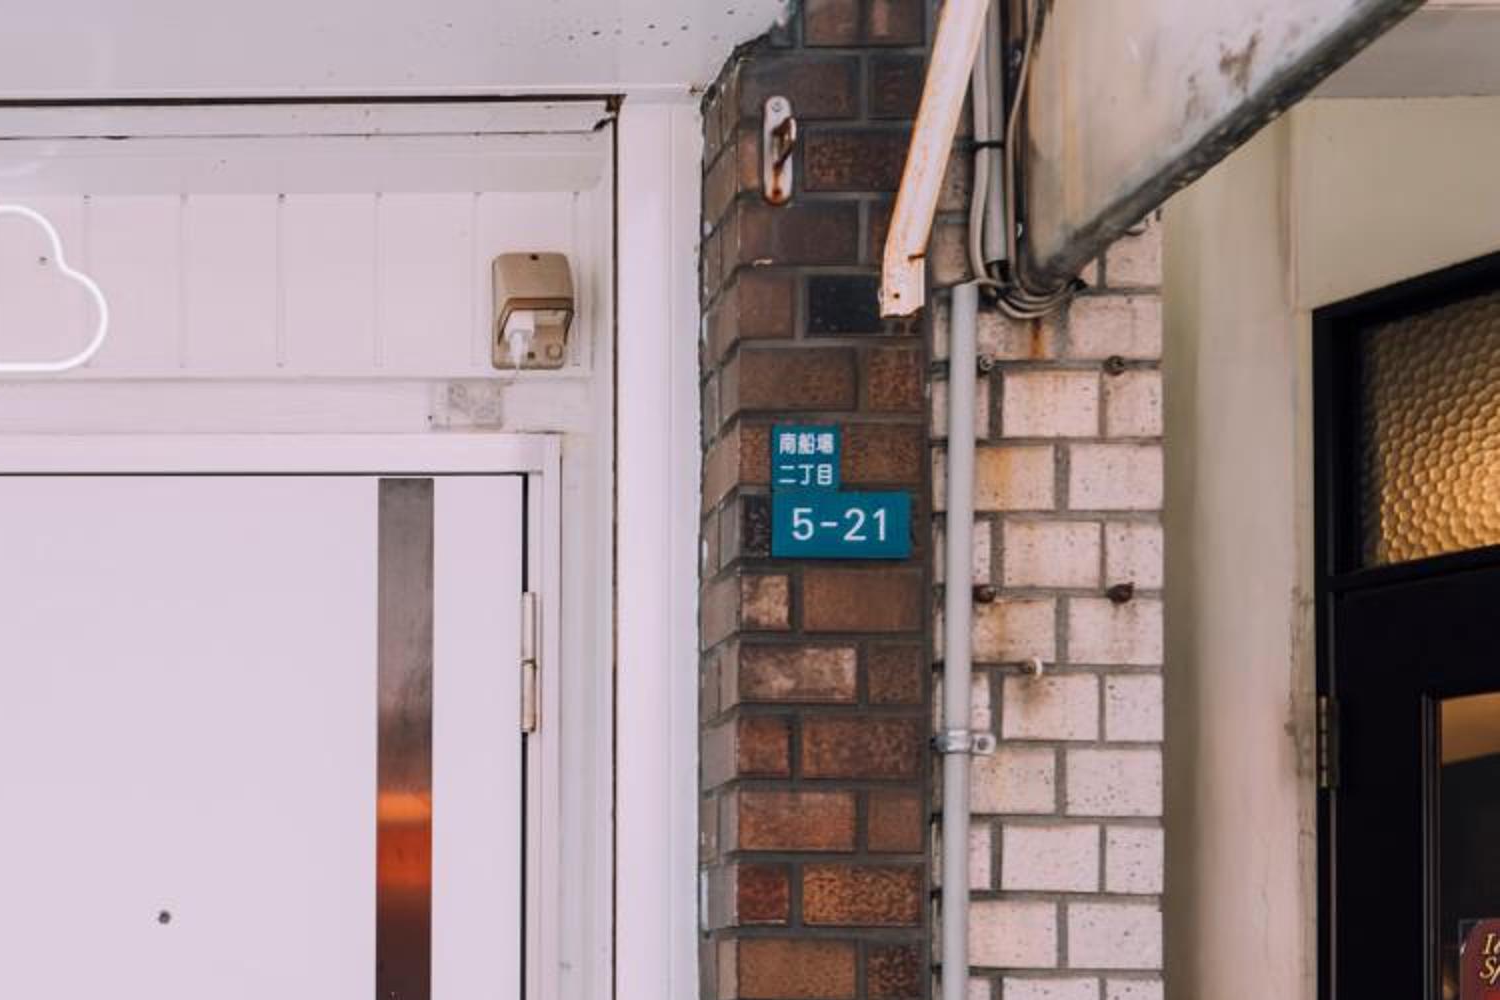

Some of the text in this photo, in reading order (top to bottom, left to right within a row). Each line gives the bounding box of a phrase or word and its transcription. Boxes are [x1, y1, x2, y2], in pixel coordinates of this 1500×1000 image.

[778, 432, 834, 455] 南船場
[778, 463, 834, 486] 二丁目
[791, 507, 888, 541] 5-21
